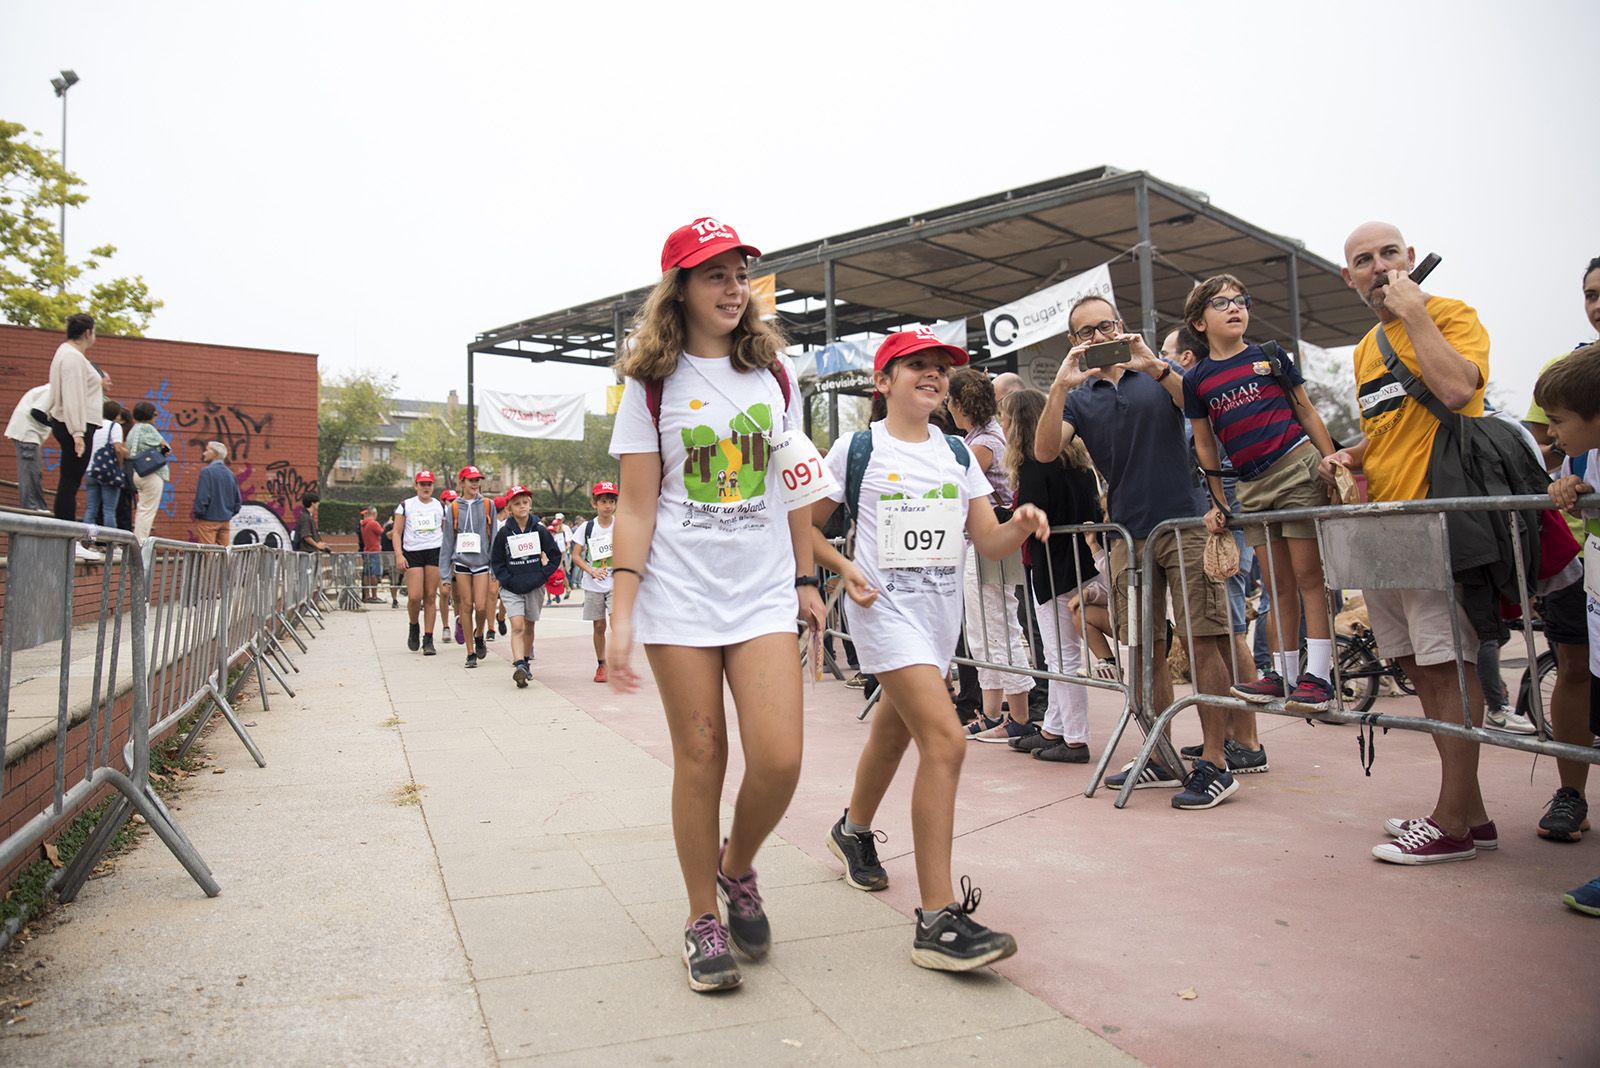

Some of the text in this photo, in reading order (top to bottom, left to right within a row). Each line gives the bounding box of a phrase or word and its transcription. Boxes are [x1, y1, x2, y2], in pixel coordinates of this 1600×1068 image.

[1022, 299, 1065, 327] cugat
[1209, 382, 1260, 410] QATAR
[782, 457, 823, 491] 097
[701, 503, 735, 514] Marxa
[518, 542, 534, 552] 098
[599, 543, 614, 554] 098
[904, 529, 946, 551] 097
